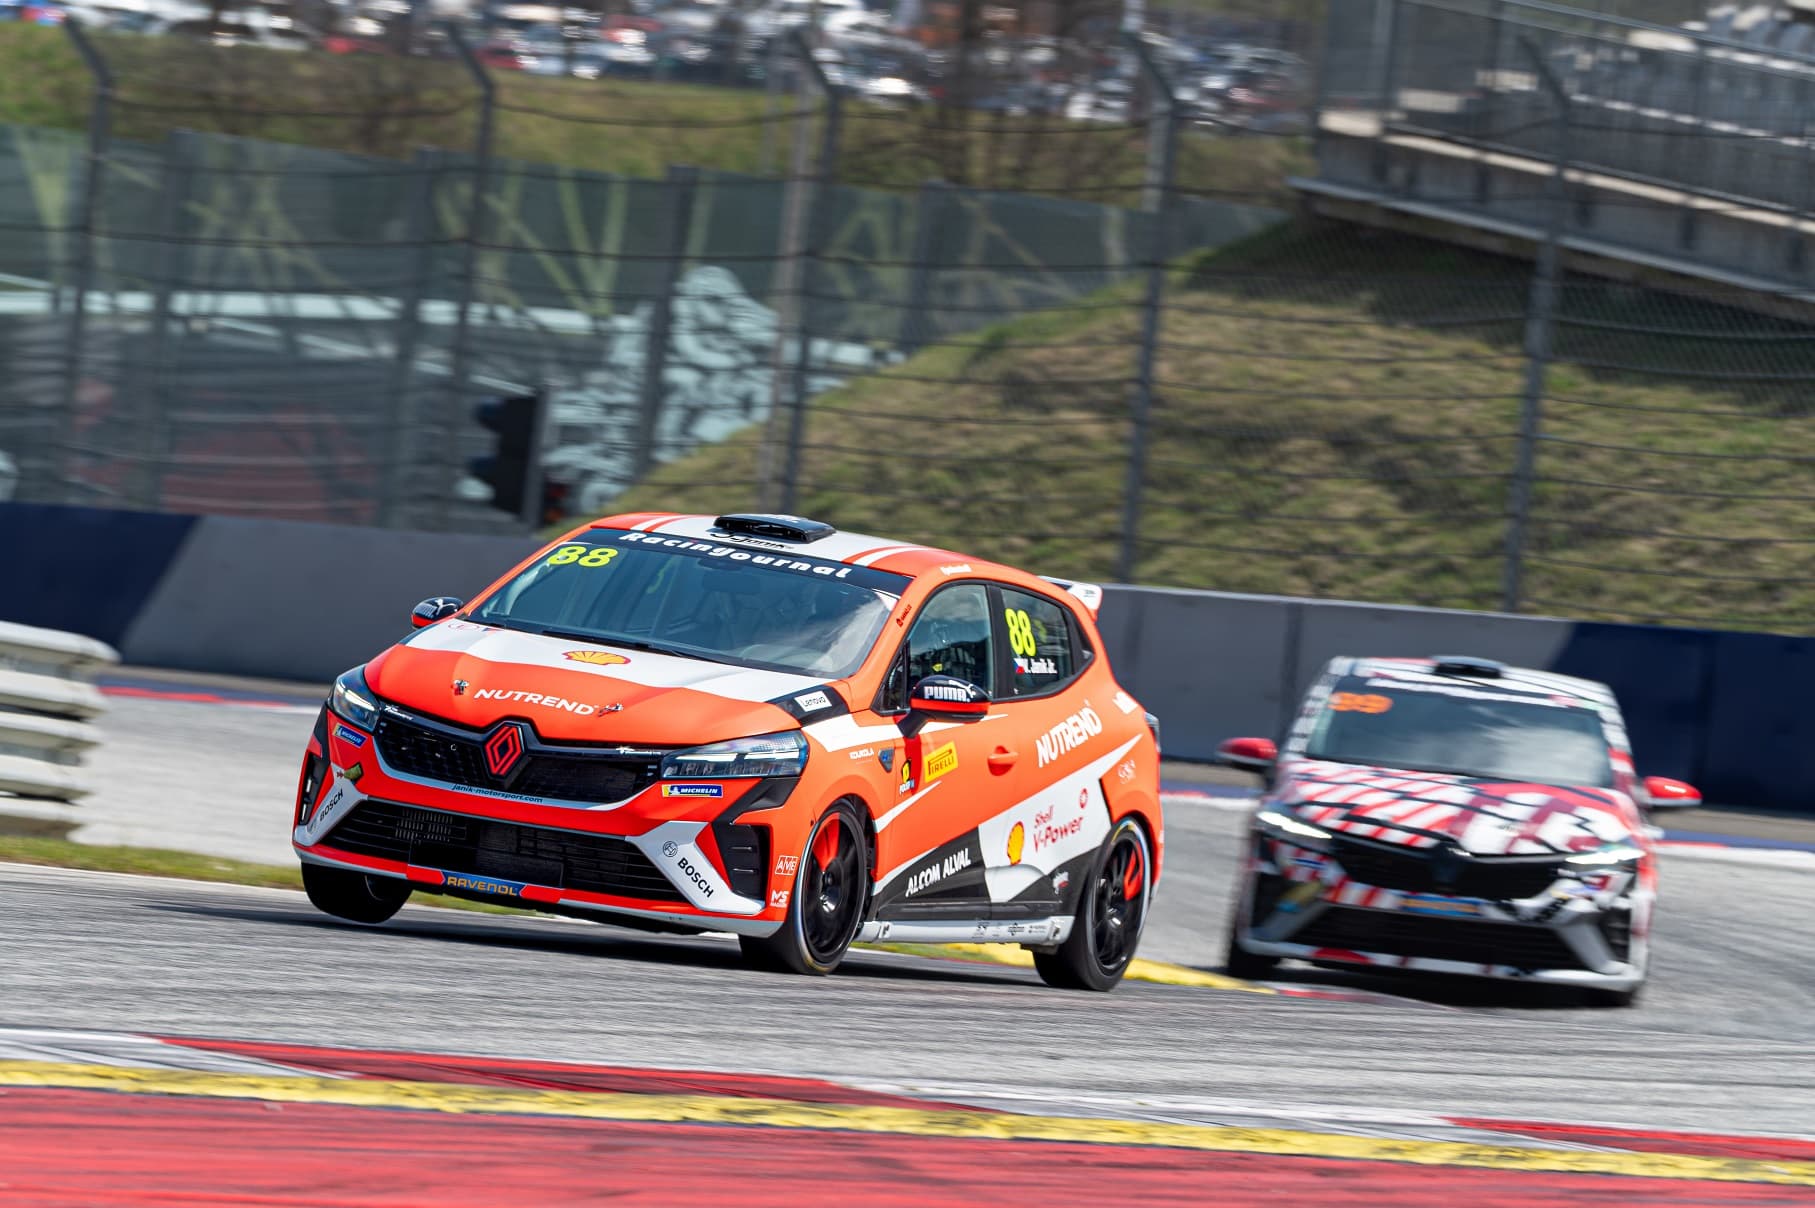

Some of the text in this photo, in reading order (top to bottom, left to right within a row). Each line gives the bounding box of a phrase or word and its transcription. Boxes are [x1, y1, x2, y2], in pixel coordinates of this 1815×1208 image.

[547, 545, 618, 567] 88
[1005, 608, 1036, 657] 88
[474, 689, 594, 715] NUTREND
[1035, 707, 1102, 768] NUTREND
[928, 748, 954, 776] PIRELLI
[320, 788, 343, 821] BOSCH
[680, 787, 718, 795] MICHELIN
[1034, 804, 1054, 829] Shell
[1033, 816, 1084, 853] V-Power
[447, 876, 517, 896] RAVENOL
[677, 857, 714, 898] BOSCH
[905, 848, 971, 897] ALCOM ALVAL
